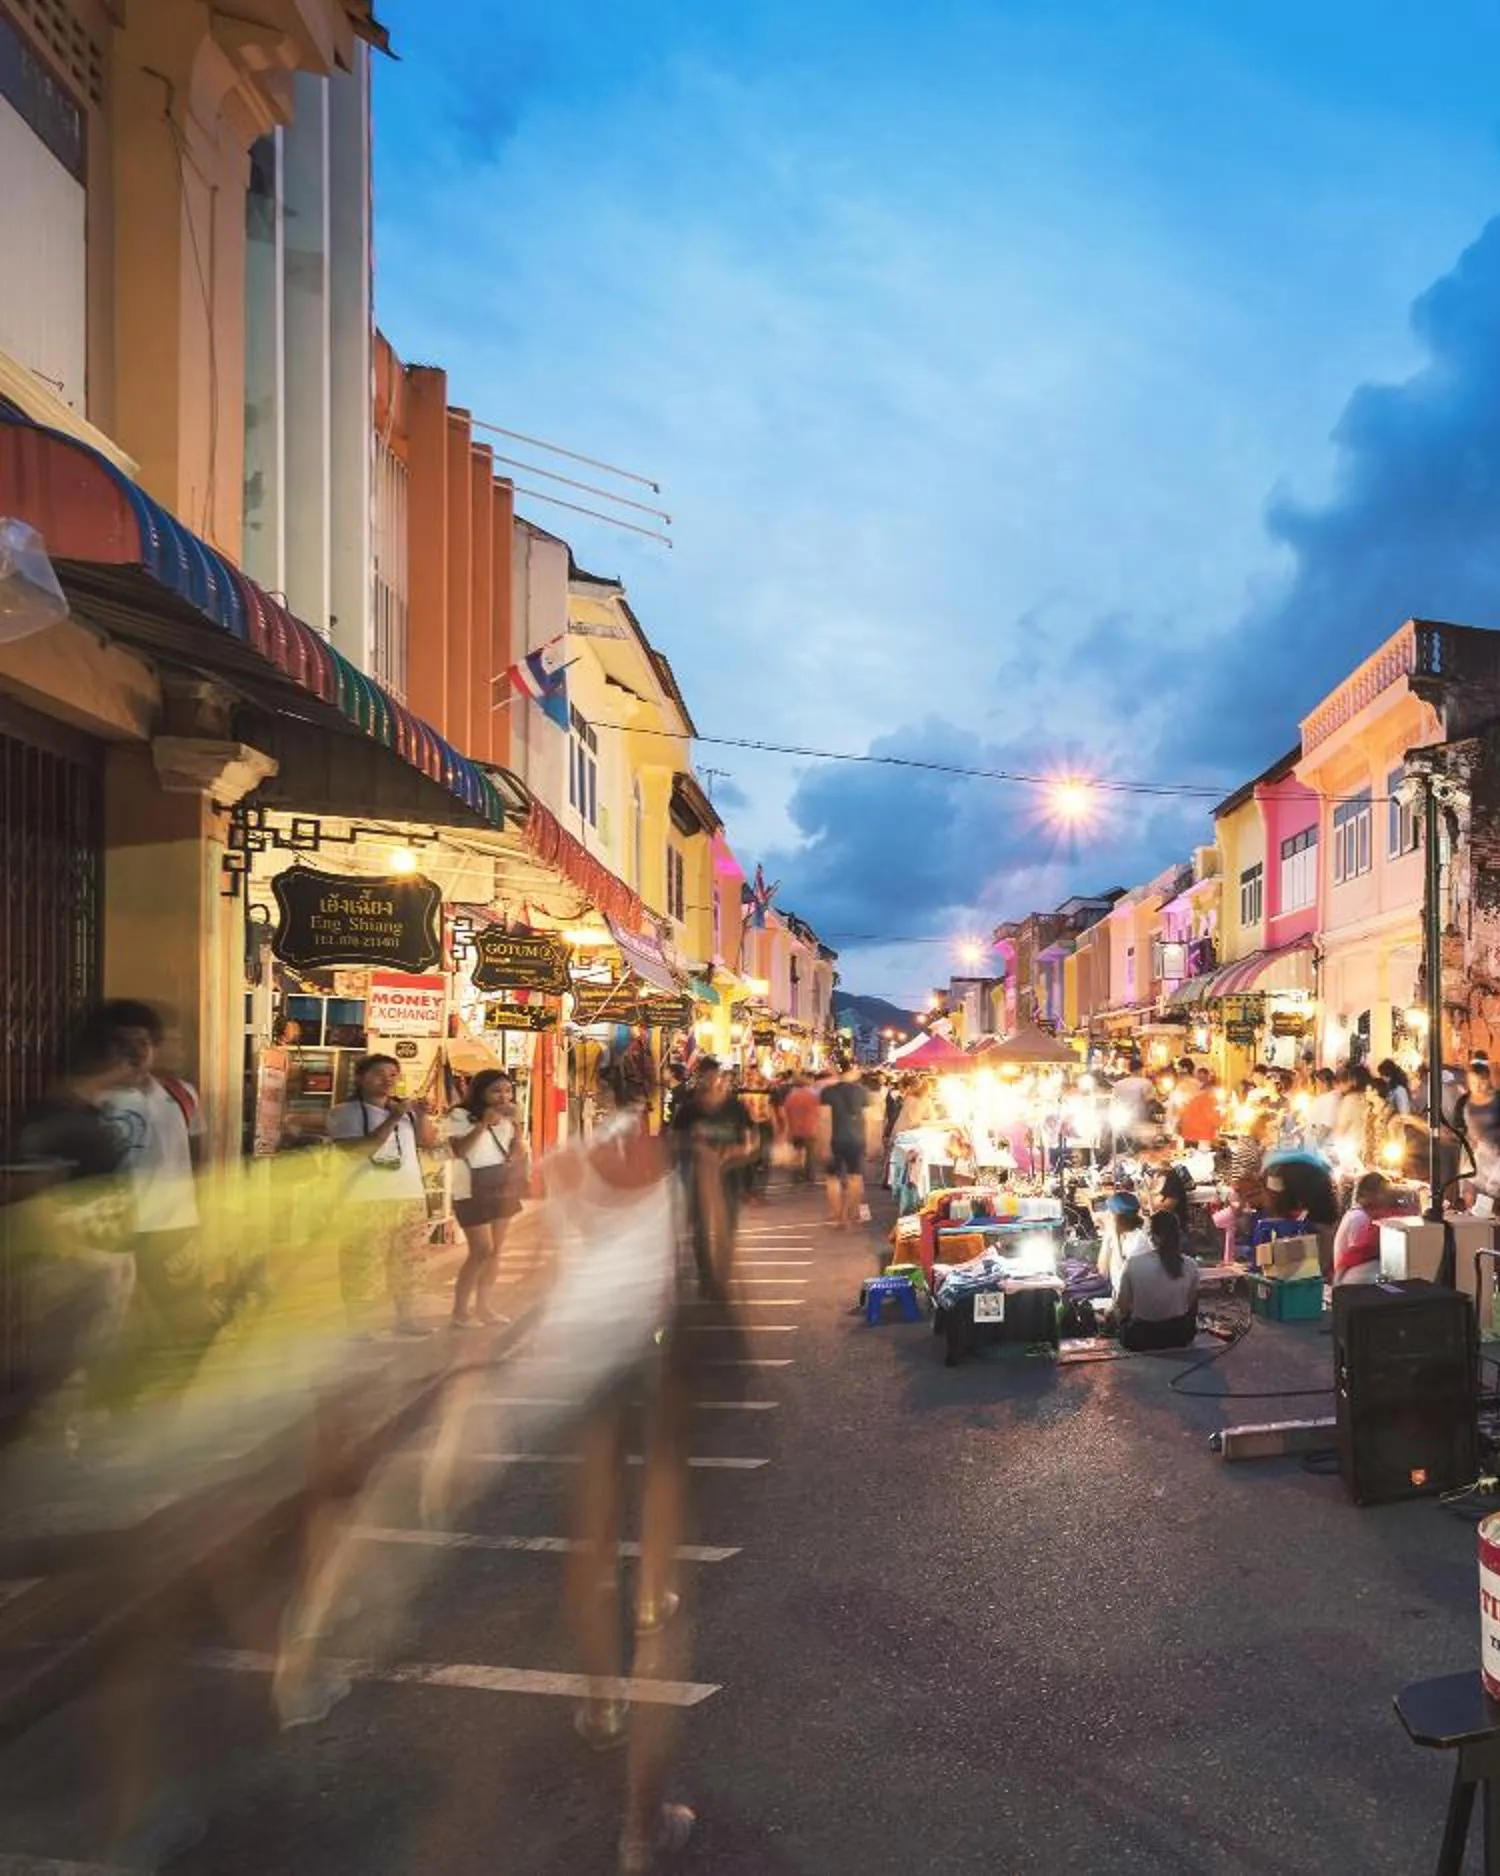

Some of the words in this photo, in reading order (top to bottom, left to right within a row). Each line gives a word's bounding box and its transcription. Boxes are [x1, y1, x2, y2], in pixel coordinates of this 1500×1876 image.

[310, 914, 341, 934] Eng
[350, 916, 403, 935] Shiang
[485, 943, 537, 957] GOTUM
[372, 993, 445, 1006] MONEY
